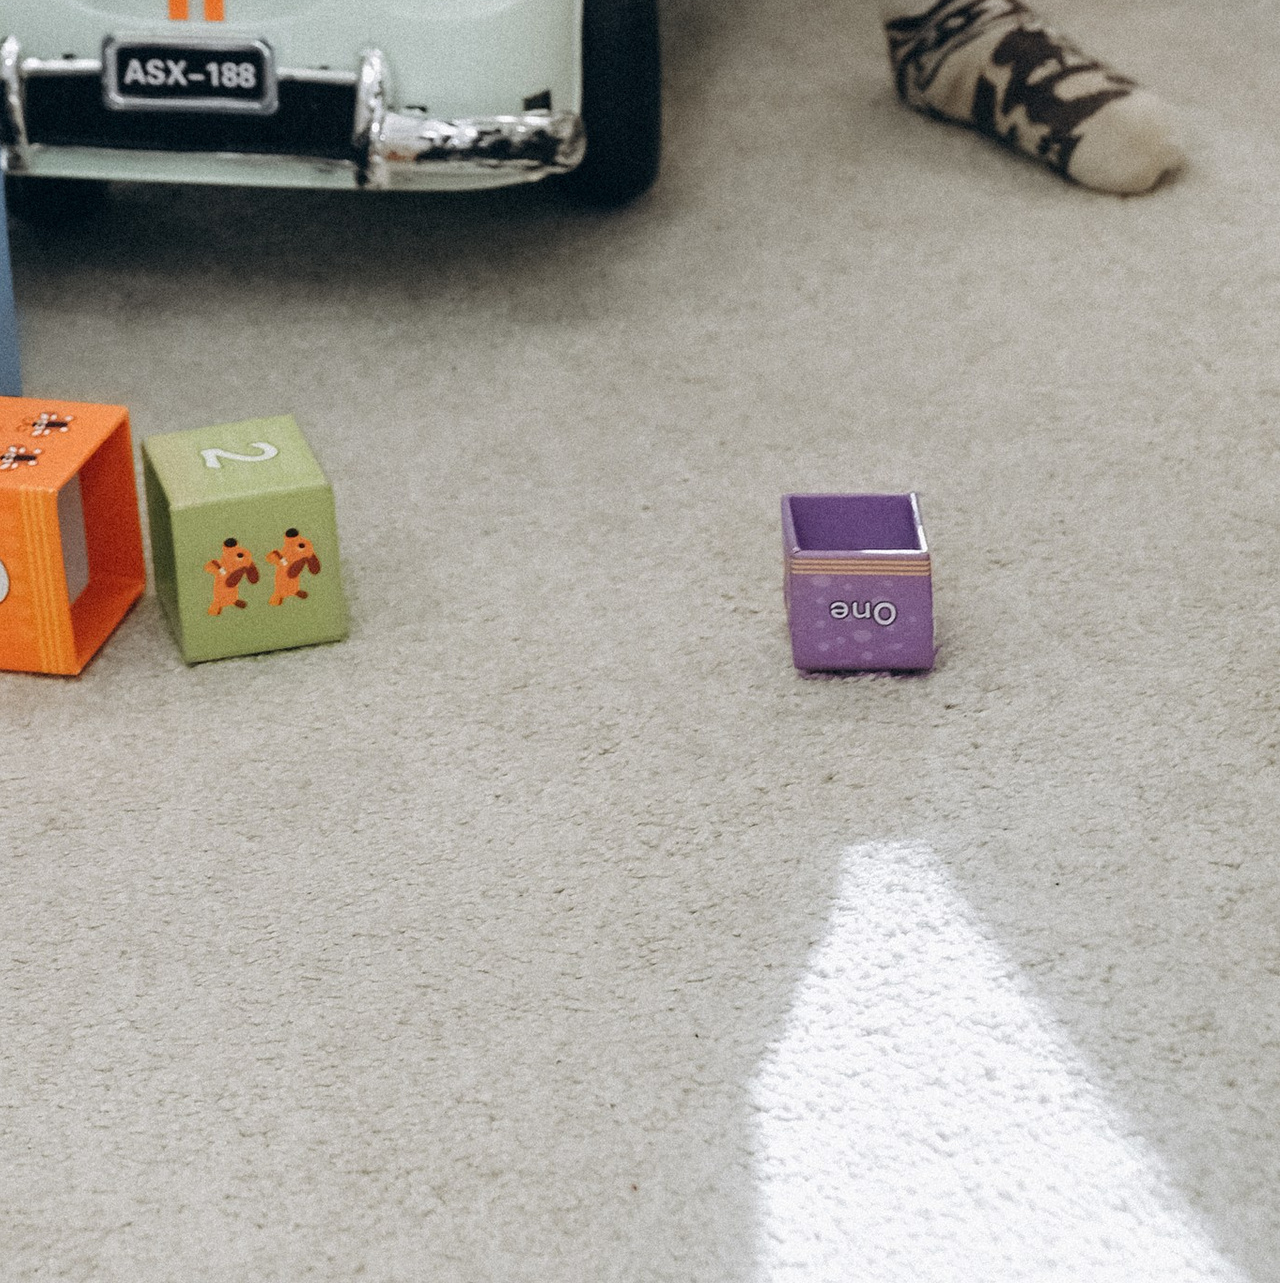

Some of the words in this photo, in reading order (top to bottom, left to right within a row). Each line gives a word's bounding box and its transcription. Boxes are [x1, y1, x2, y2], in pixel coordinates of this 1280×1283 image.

[123, 58, 256, 89] ASX-188
[200, 442, 278, 469] 2
[829, 600, 897, 625] One
